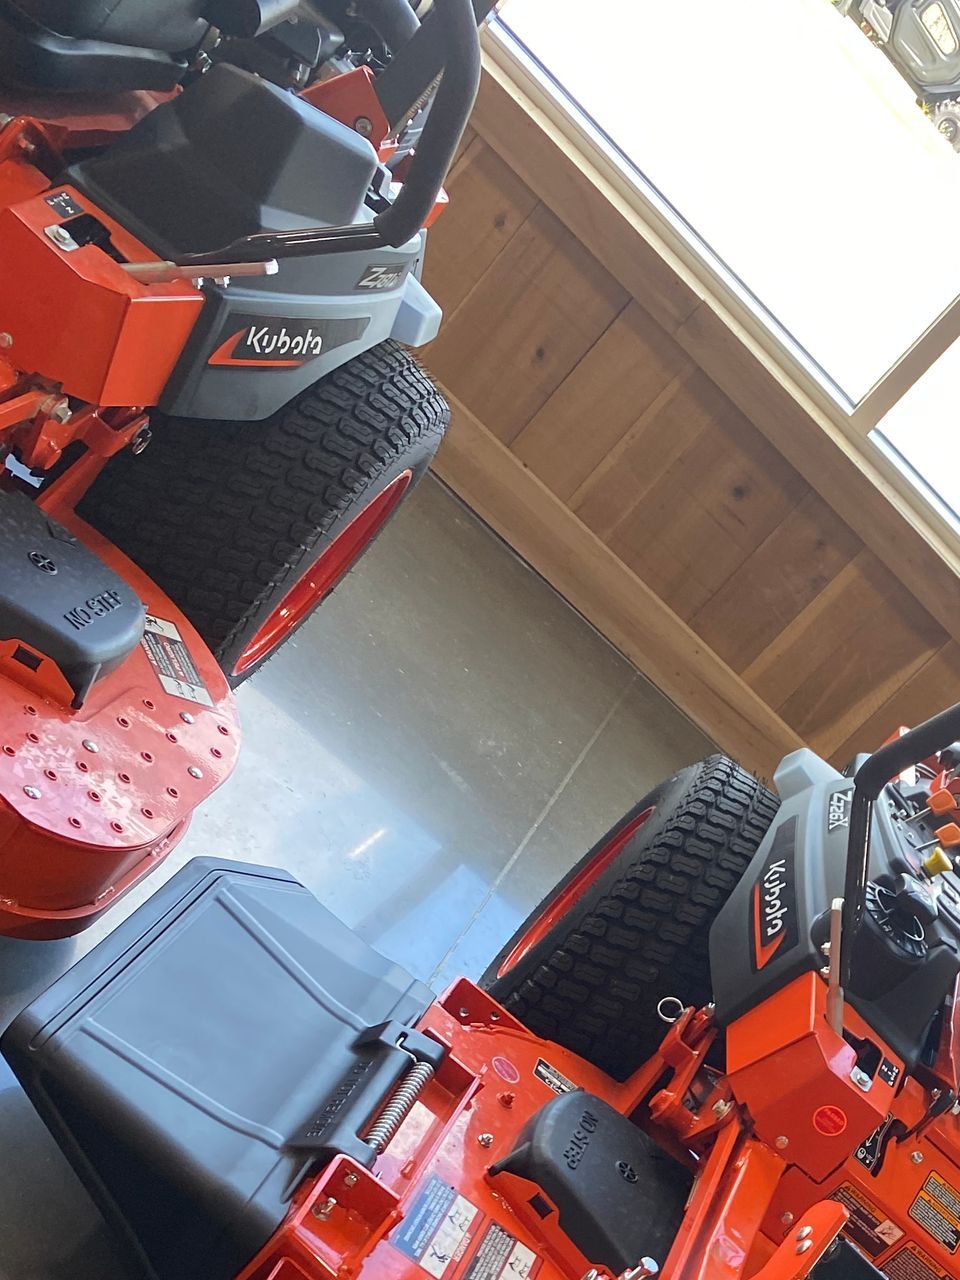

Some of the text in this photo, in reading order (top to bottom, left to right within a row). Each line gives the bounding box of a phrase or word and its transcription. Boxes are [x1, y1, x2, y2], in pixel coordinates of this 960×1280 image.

[246, 326, 322, 355] Kubota
[63, 589, 123, 631] NO STEP
[828, 790, 853, 831] Z726X
[763, 859, 788, 936] Kubota
[563, 1110, 599, 1170] NO STEP
[849, 1187, 877, 1214] WARNING
[916, 1250, 942, 1274] WARNING
